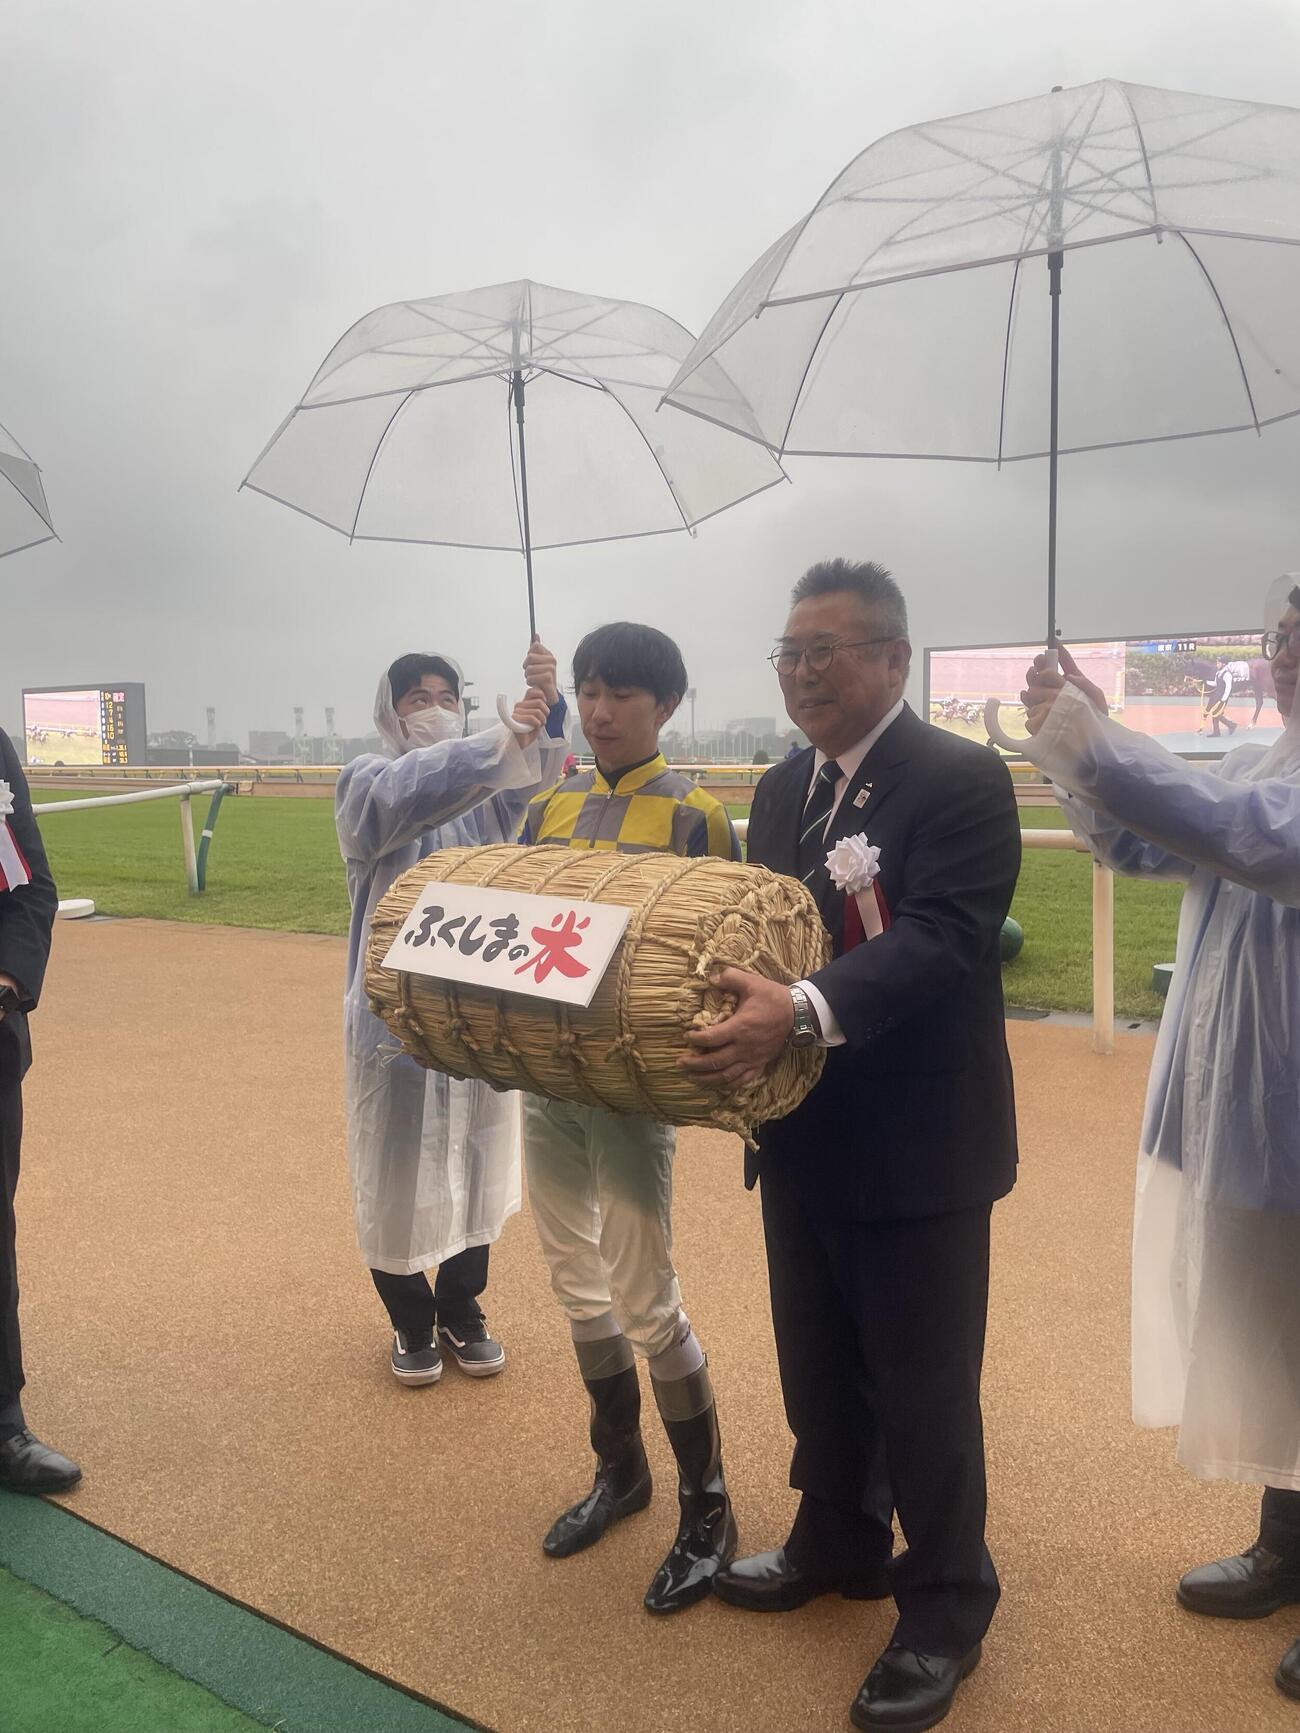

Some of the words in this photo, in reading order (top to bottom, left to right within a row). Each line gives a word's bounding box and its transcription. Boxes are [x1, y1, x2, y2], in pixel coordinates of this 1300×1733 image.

[1177, 643, 1195, 651] 11R
[404, 905, 592, 984] ふくしまの米
